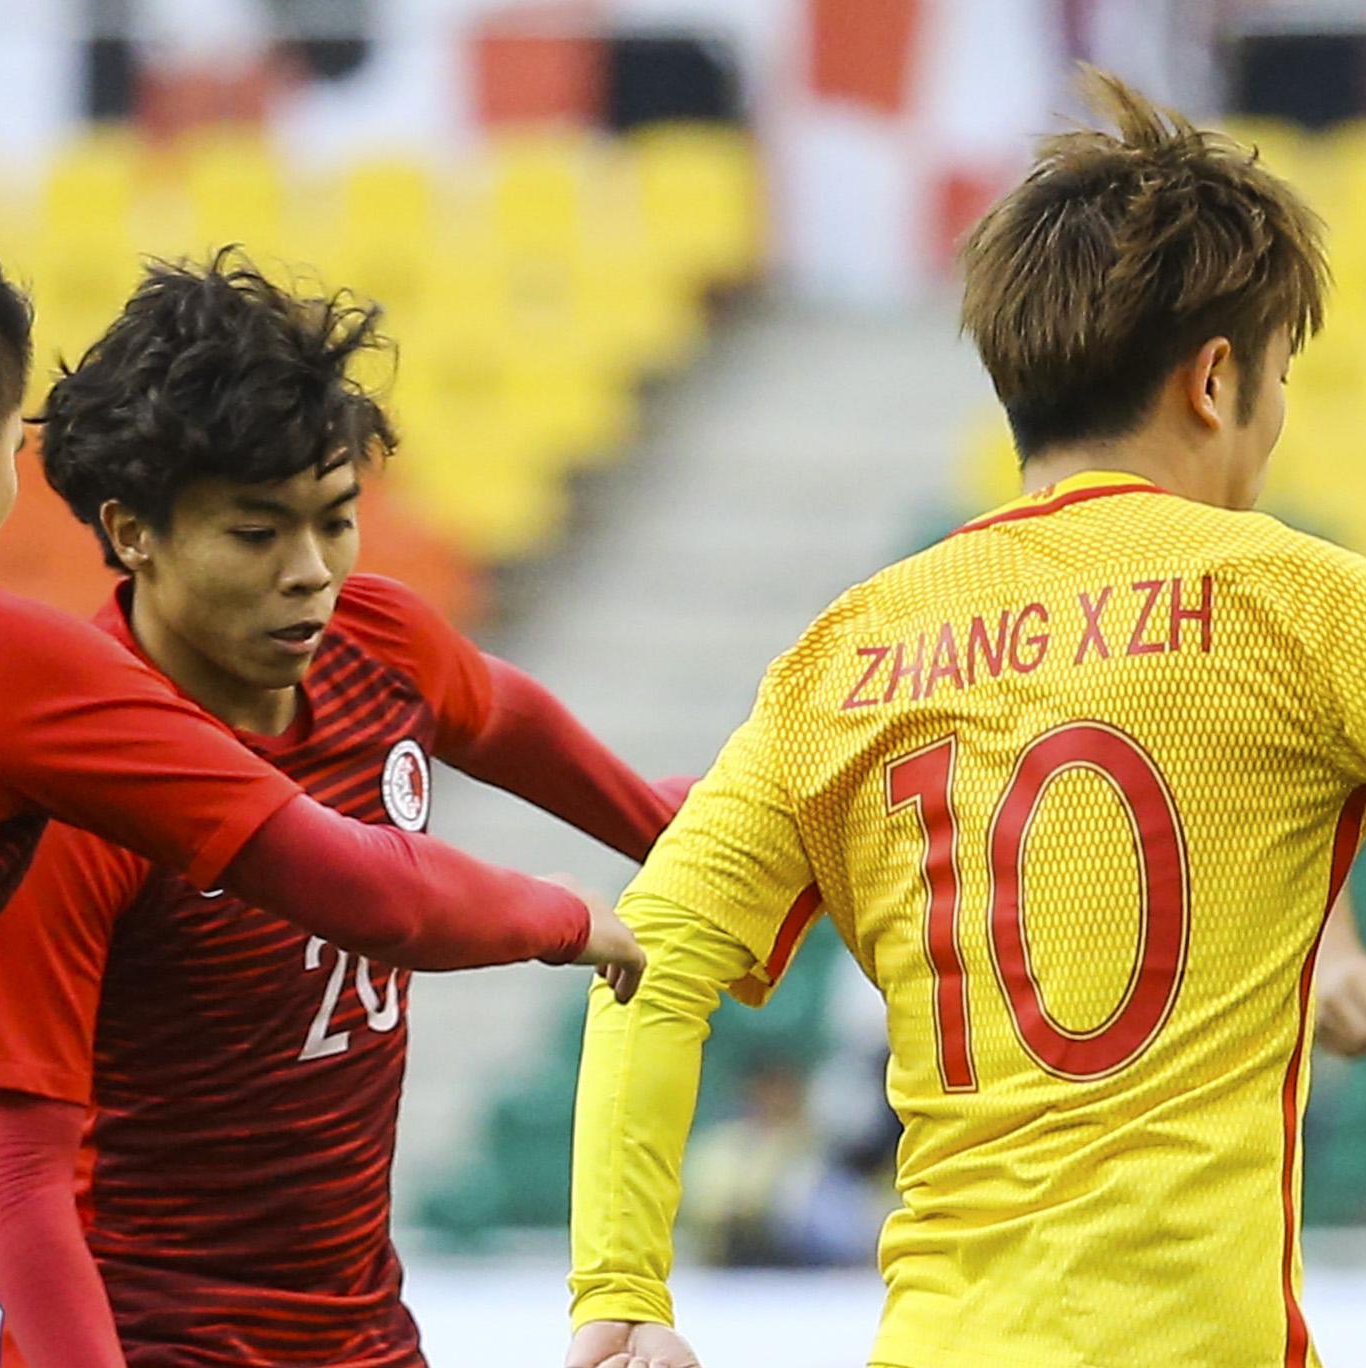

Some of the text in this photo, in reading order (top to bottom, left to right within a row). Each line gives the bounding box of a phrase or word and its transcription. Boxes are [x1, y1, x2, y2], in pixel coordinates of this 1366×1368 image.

[840, 574, 1218, 711] ZHANG X ZH
[884, 717, 1192, 1095] 10
